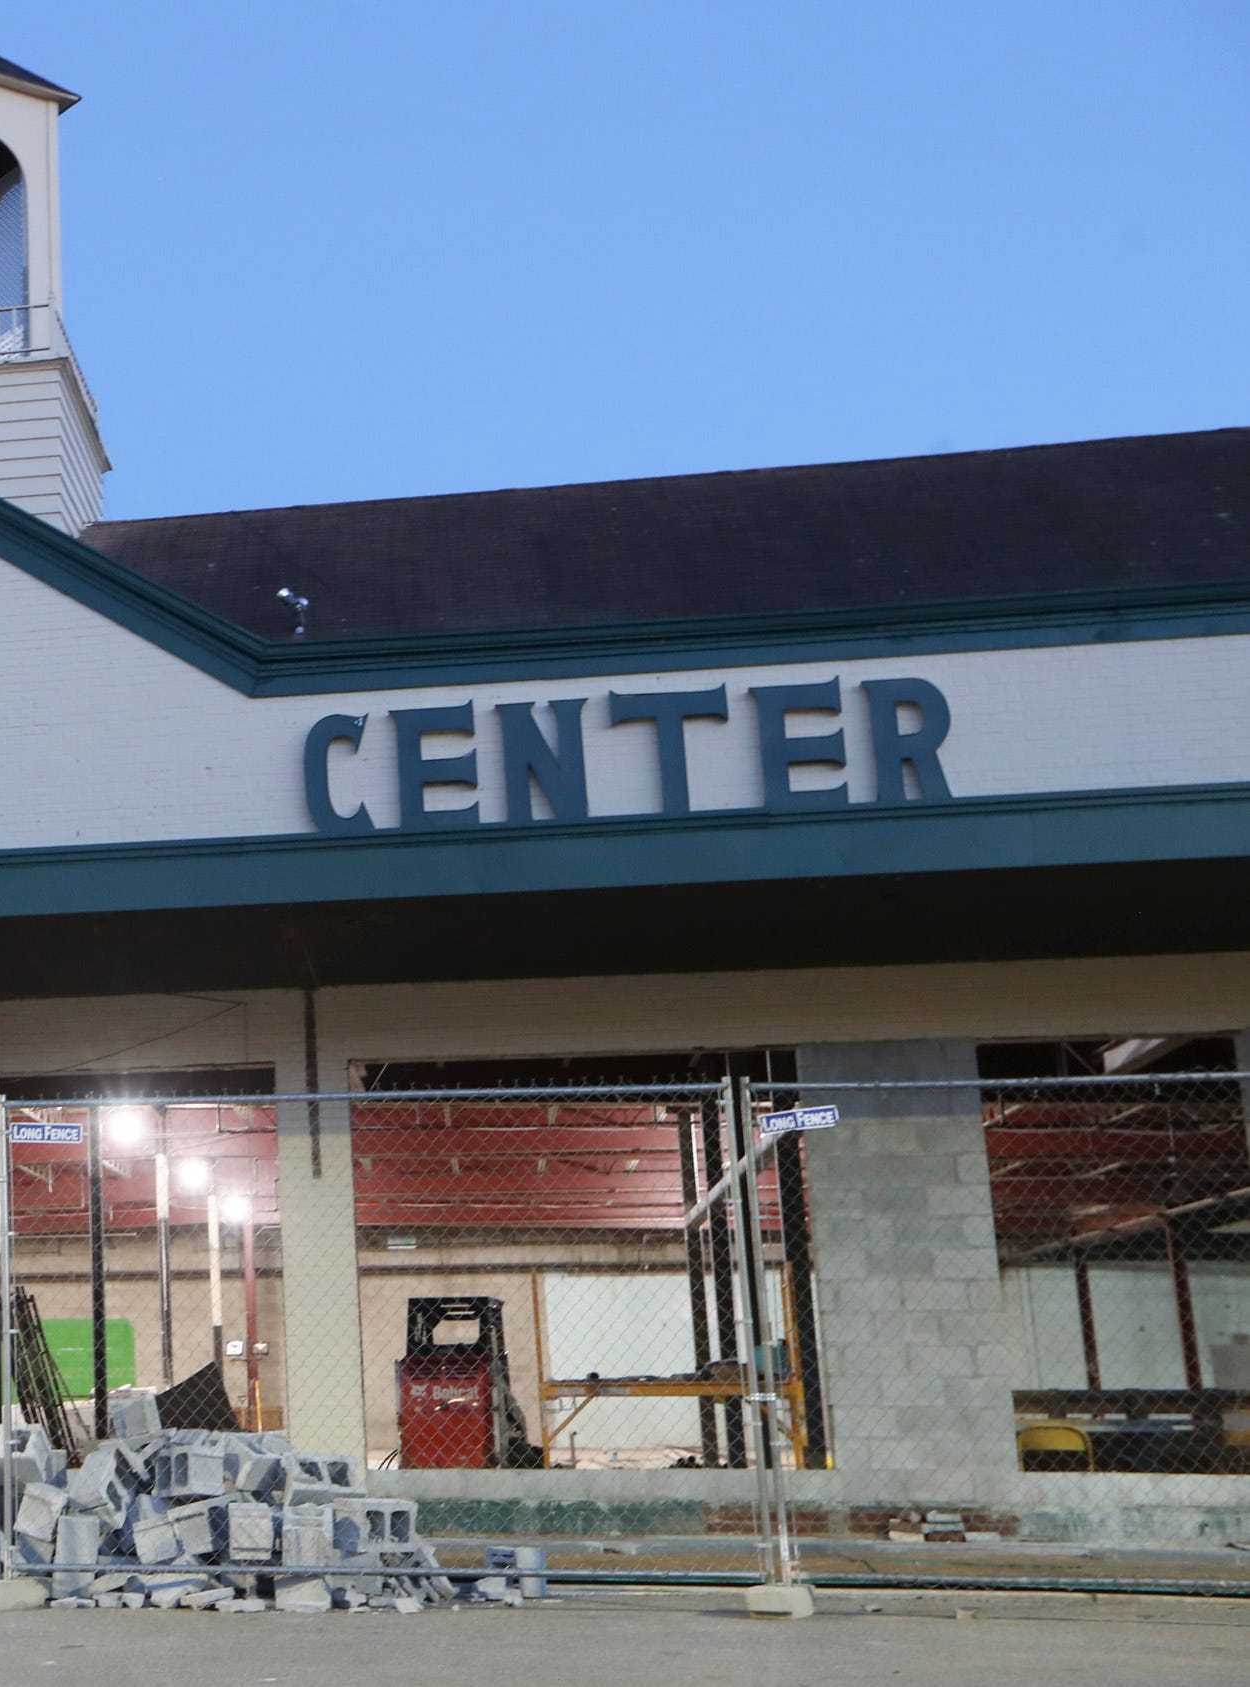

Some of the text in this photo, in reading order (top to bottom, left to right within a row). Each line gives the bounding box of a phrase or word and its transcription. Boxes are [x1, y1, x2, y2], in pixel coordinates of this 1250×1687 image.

[303, 675, 953, 832] CENTER
[762, 1110, 834, 1132] LONG FENCE
[13, 1125, 79, 1141] LONG FENCE
[432, 1385, 479, 1400] Bobcat
